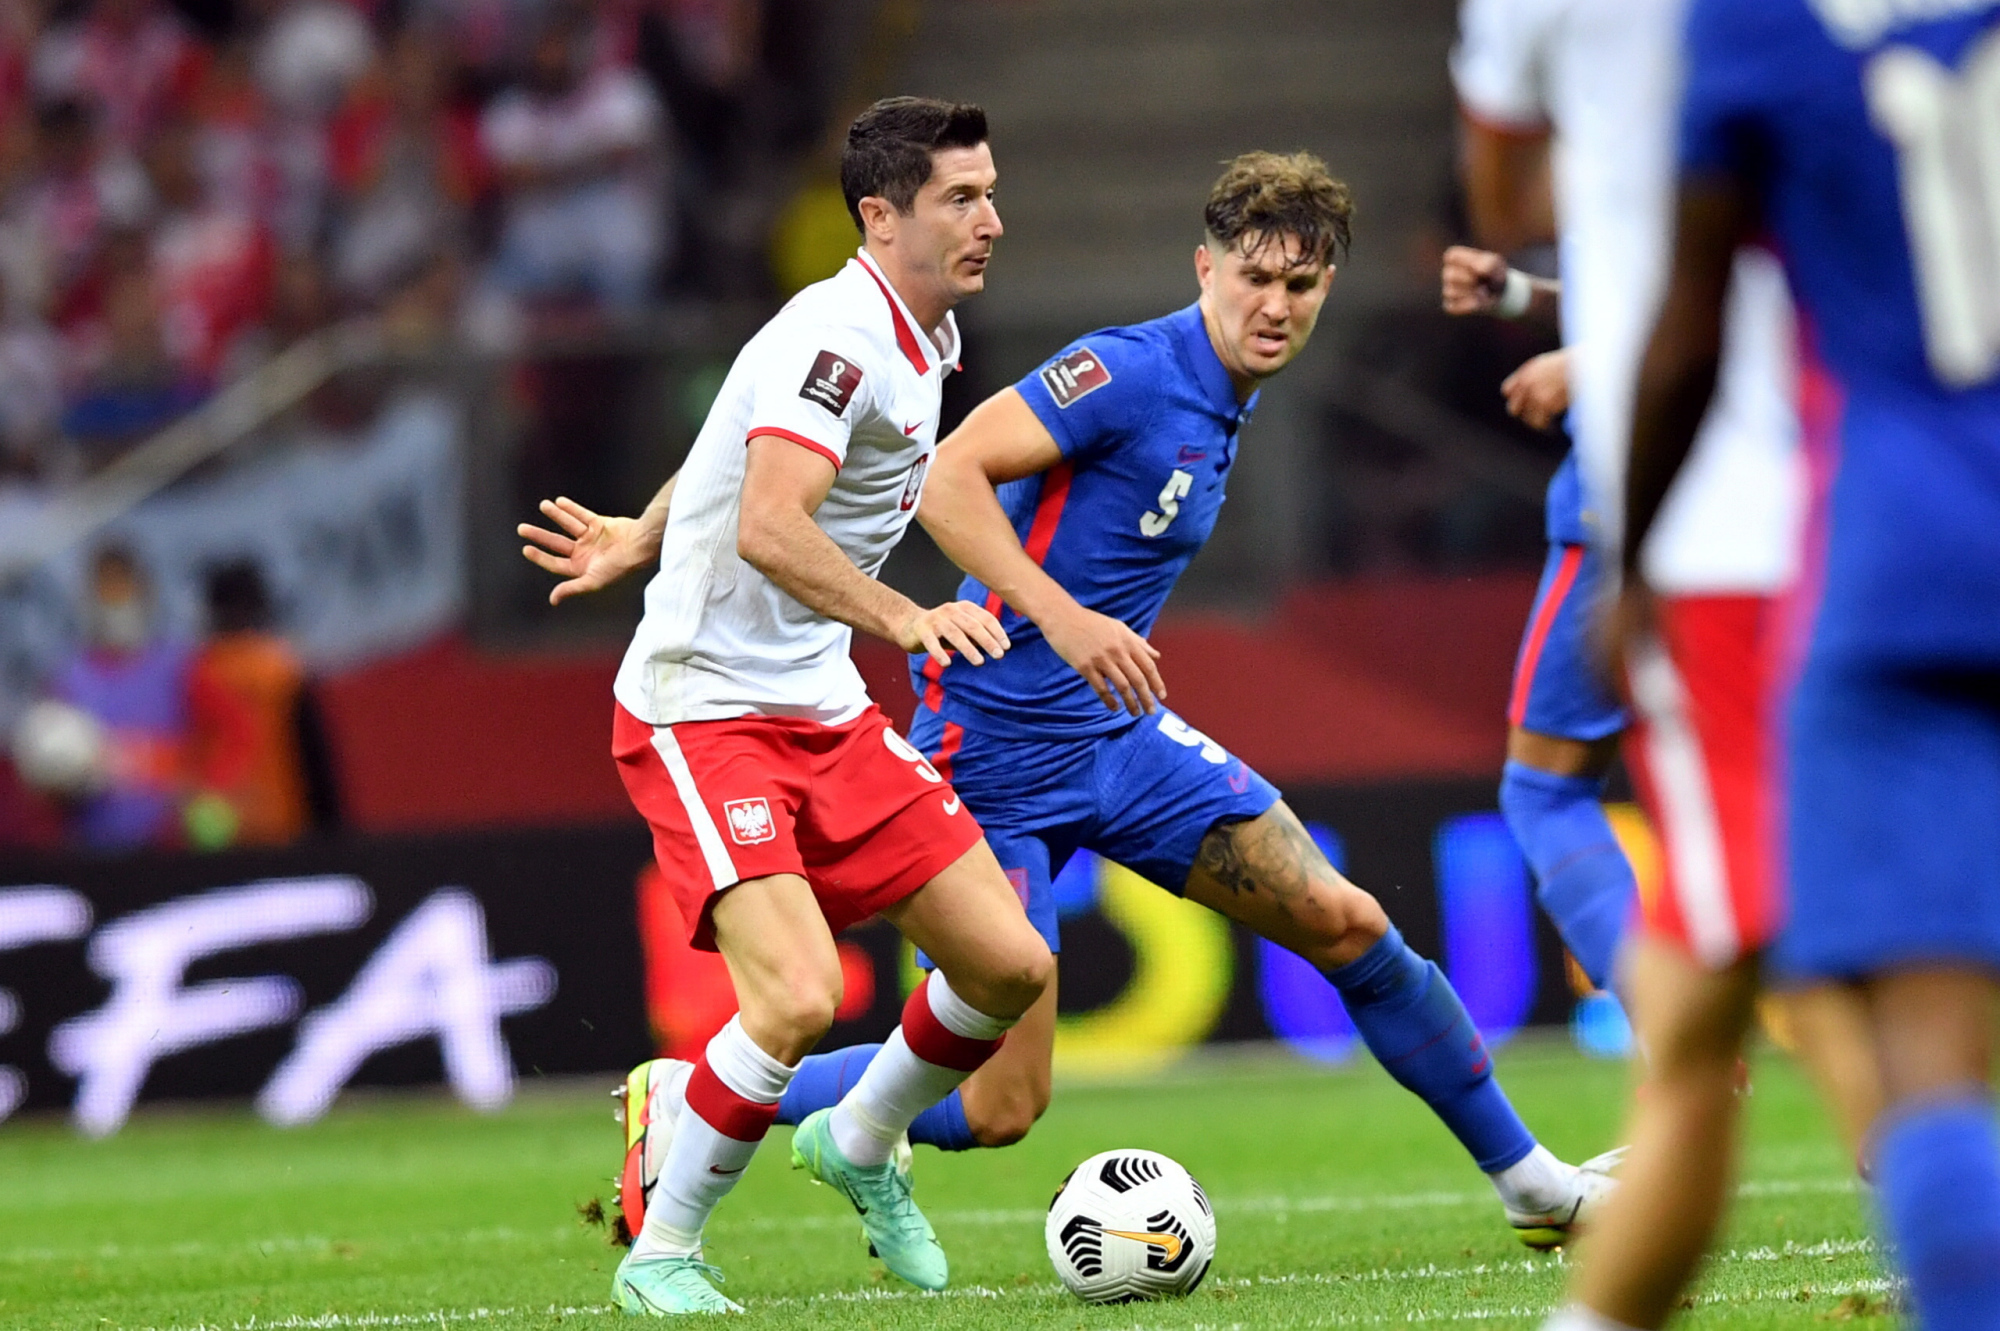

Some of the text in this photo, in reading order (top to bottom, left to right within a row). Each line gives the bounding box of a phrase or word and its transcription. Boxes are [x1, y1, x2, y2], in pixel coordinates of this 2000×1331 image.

[1139, 468, 1194, 538] 5
[882, 726, 943, 784] 9
[1157, 712, 1228, 765] 5
